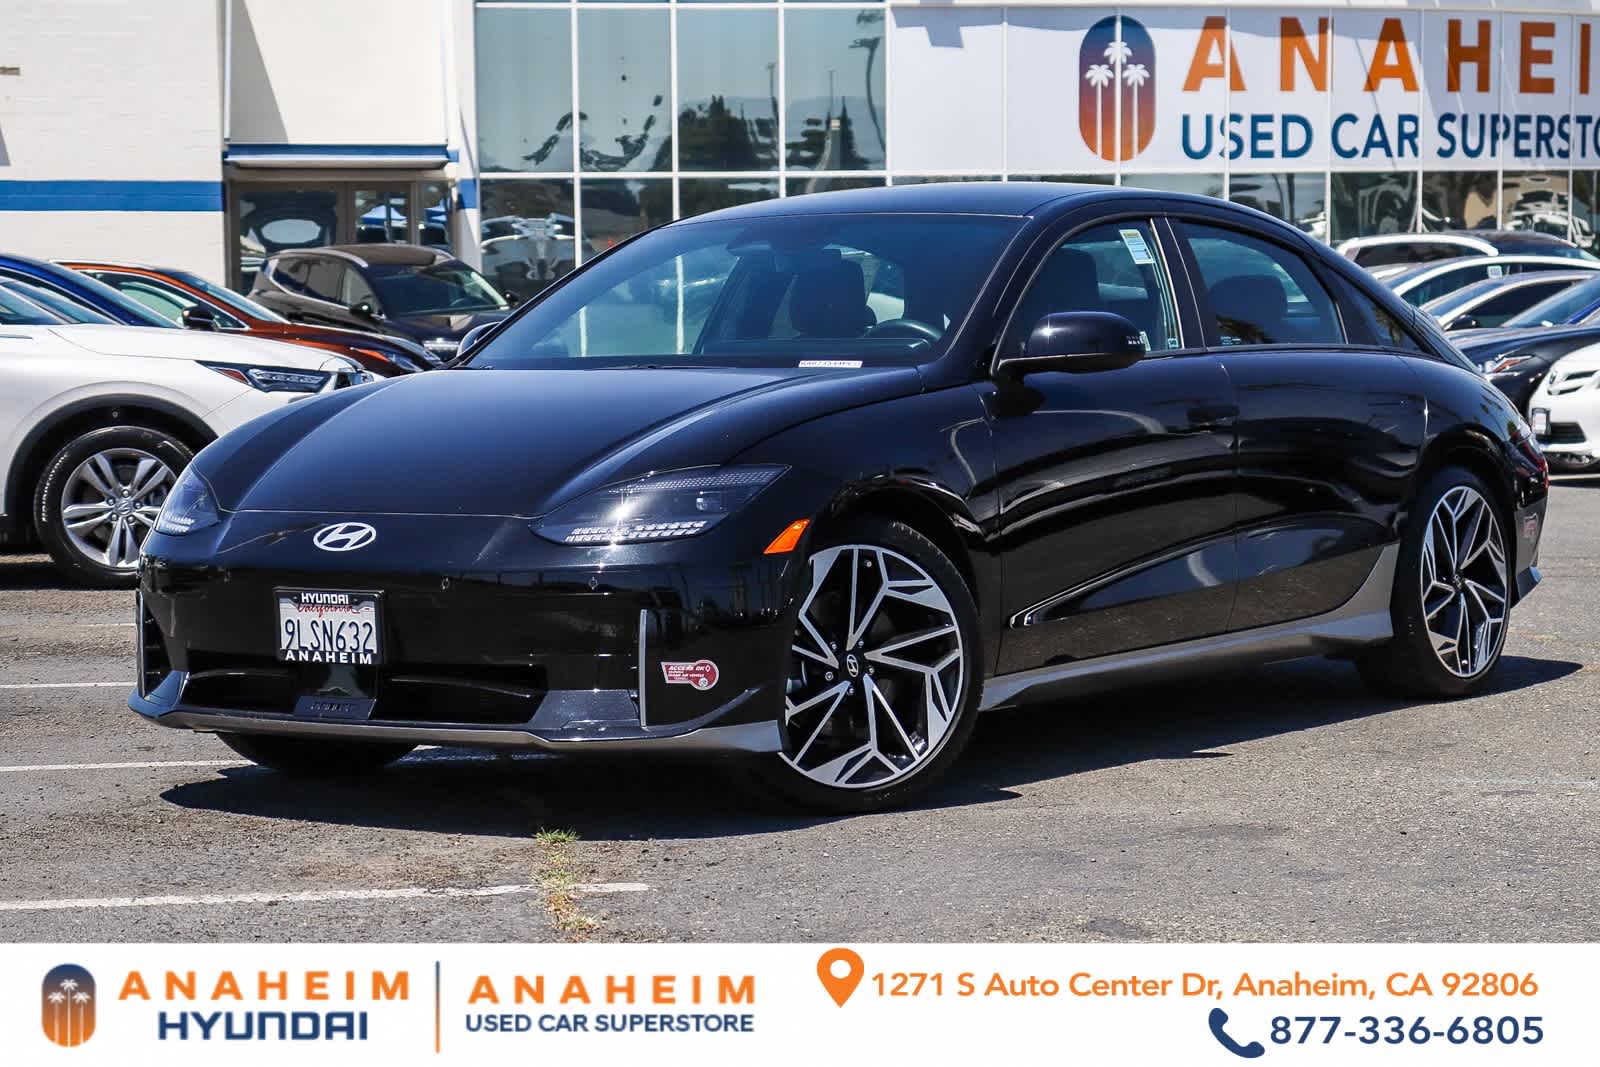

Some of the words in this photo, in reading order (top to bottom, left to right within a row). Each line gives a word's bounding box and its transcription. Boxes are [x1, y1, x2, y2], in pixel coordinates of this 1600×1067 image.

[1181, 113, 1313, 161] USED
[1331, 113, 1419, 159] CAR
[301, 592, 349, 605] HYUNDAI
[284, 619, 374, 654] 9LSN632
[285, 650, 372, 665] ANAHEIM
